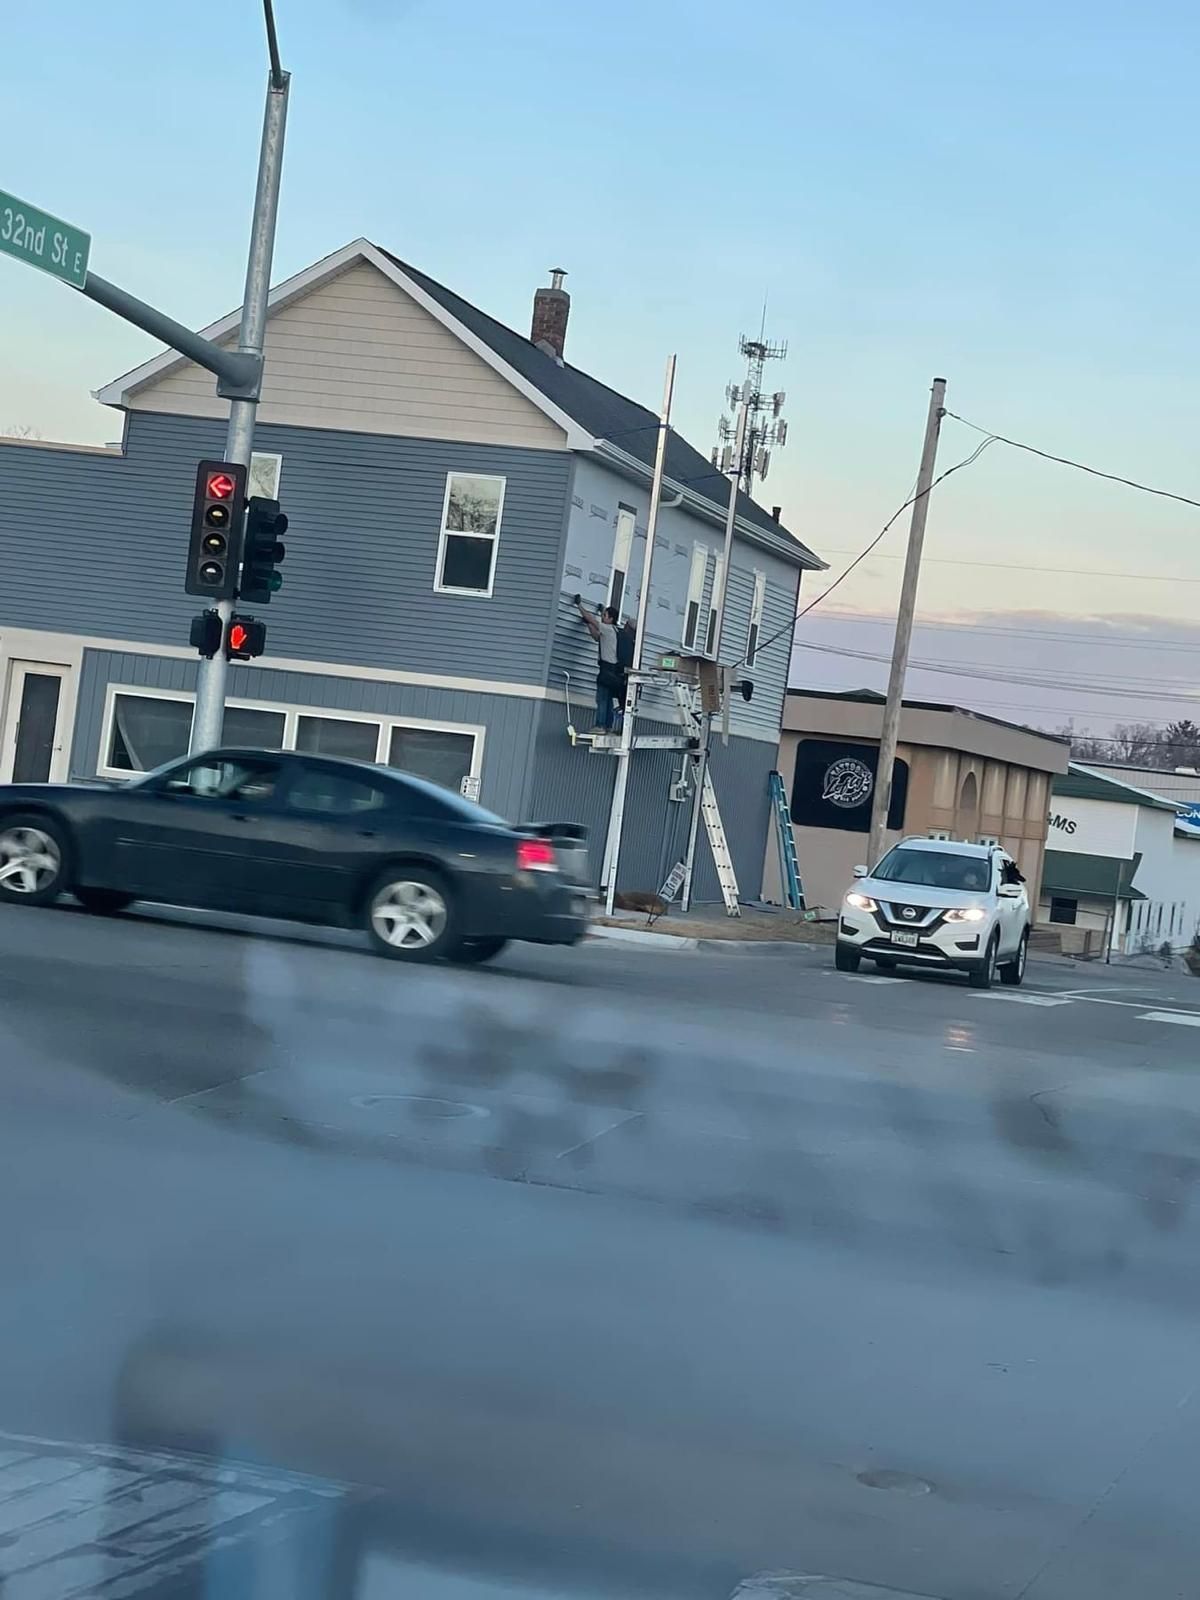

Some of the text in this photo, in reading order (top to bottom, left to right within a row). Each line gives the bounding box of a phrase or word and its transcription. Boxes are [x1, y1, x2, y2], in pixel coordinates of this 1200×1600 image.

[1, 207, 82, 273] 32nd St E
